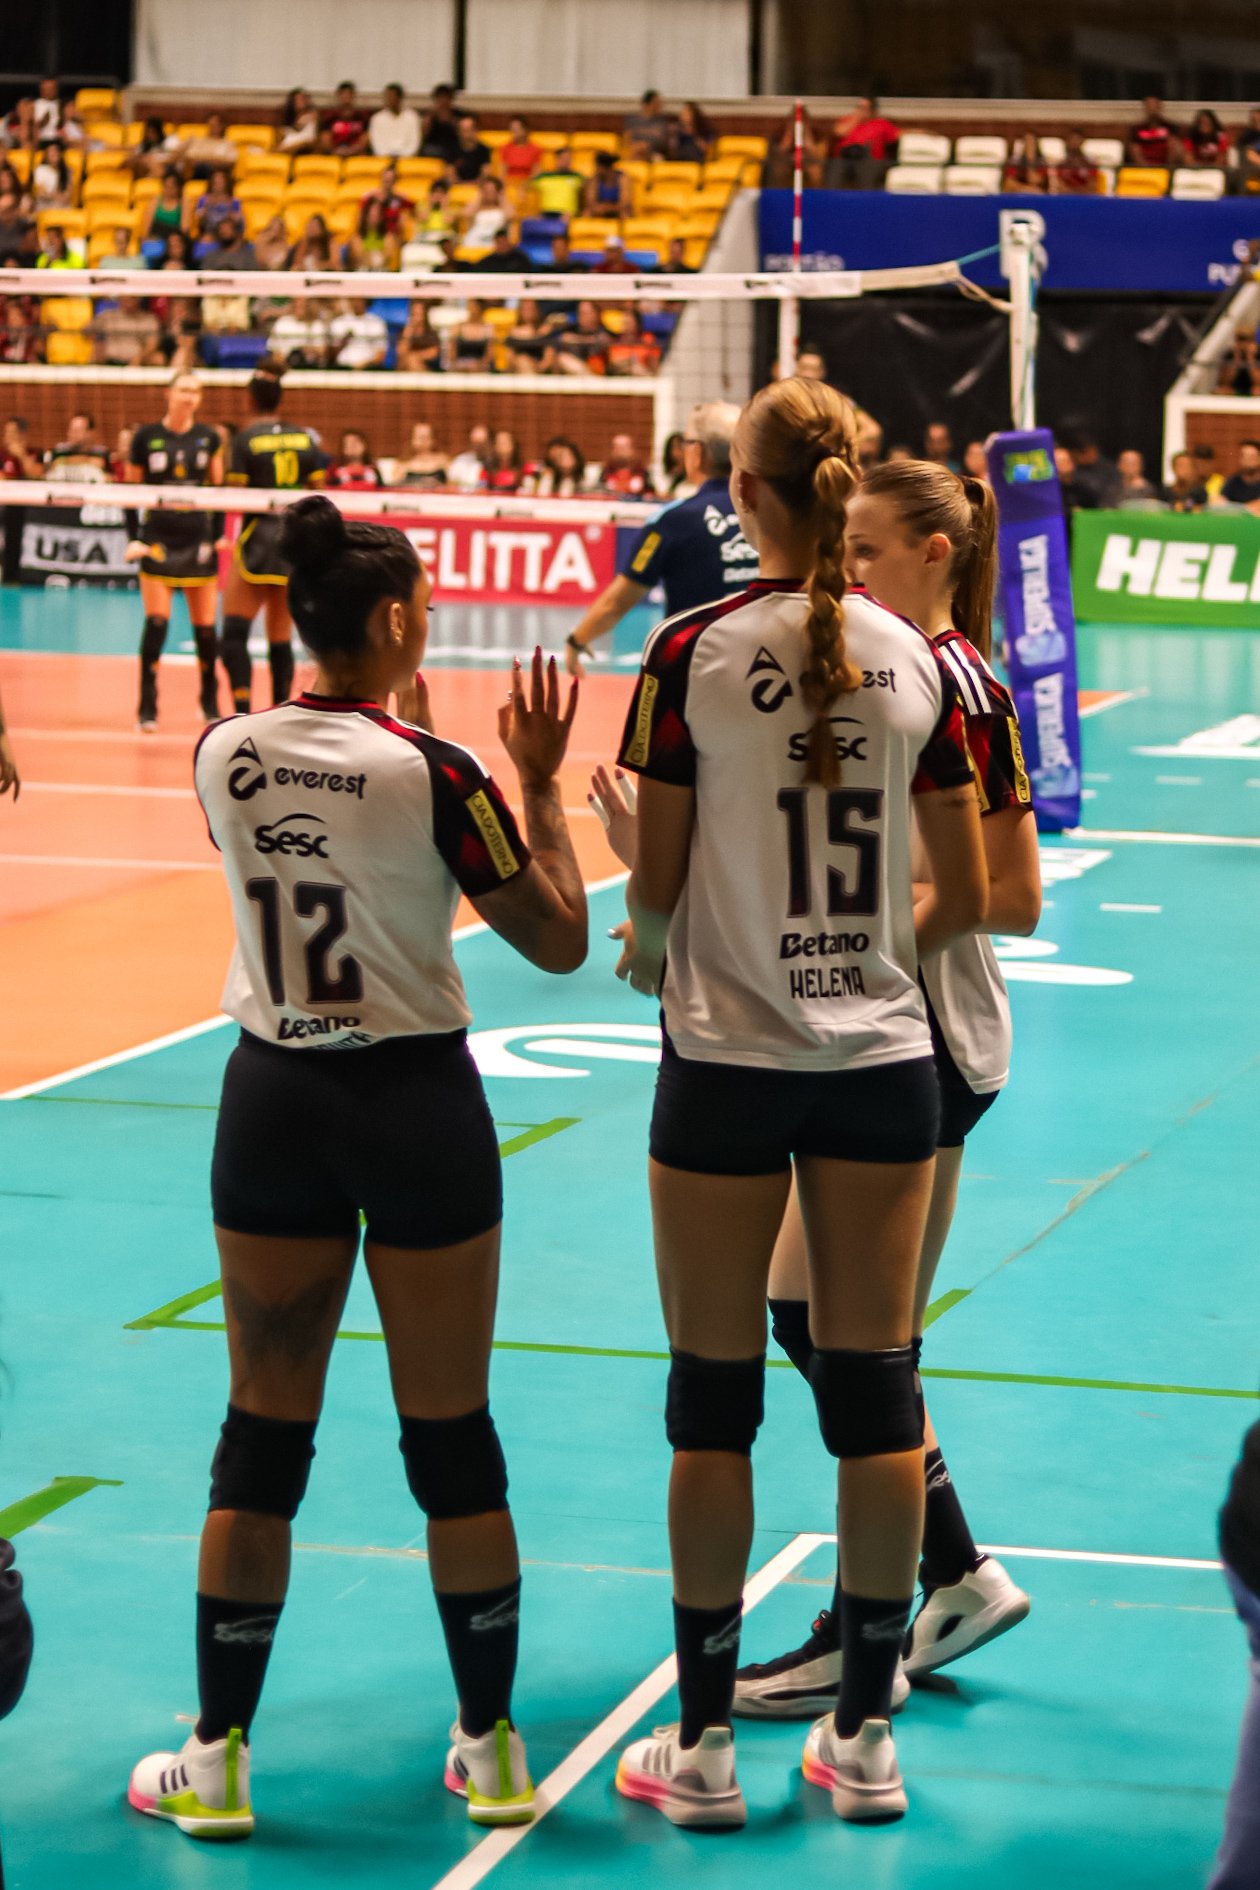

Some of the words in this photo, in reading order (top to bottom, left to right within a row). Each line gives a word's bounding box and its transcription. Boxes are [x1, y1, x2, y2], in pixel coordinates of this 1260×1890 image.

[1096, 533, 1260, 603] HEL
[273, 765, 367, 799] everest
[777, 786, 885, 919] 15
[245, 876, 364, 1006] 12
[779, 932, 870, 959] Betano
[790, 966, 866, 999] HELENA
